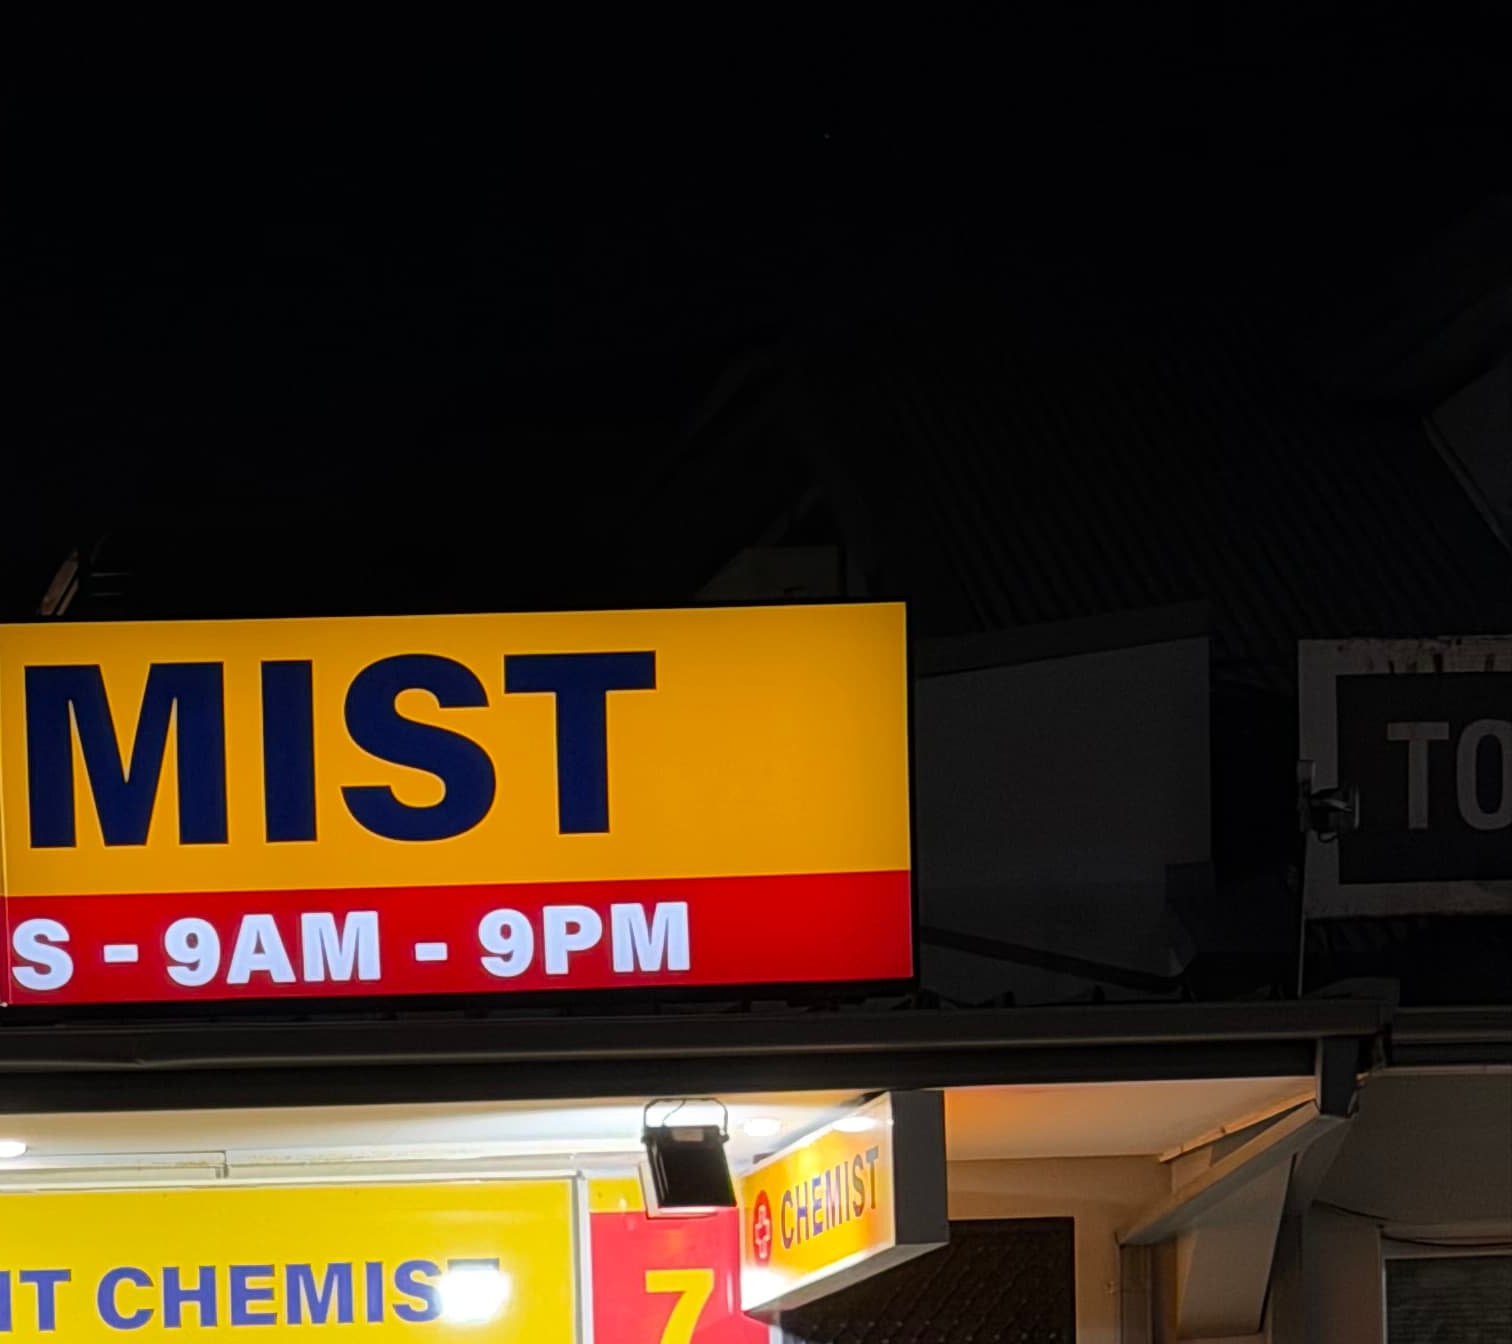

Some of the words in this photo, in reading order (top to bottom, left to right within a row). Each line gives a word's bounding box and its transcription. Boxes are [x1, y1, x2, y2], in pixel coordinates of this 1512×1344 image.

[1388, 718, 1512, 831] TO
[165, 909, 382, 987] 9AM
[479, 901, 691, 978] 9PM
[780, 1146, 879, 1250] CHEMIST
[96, 1258, 500, 1330] CHEMIS
